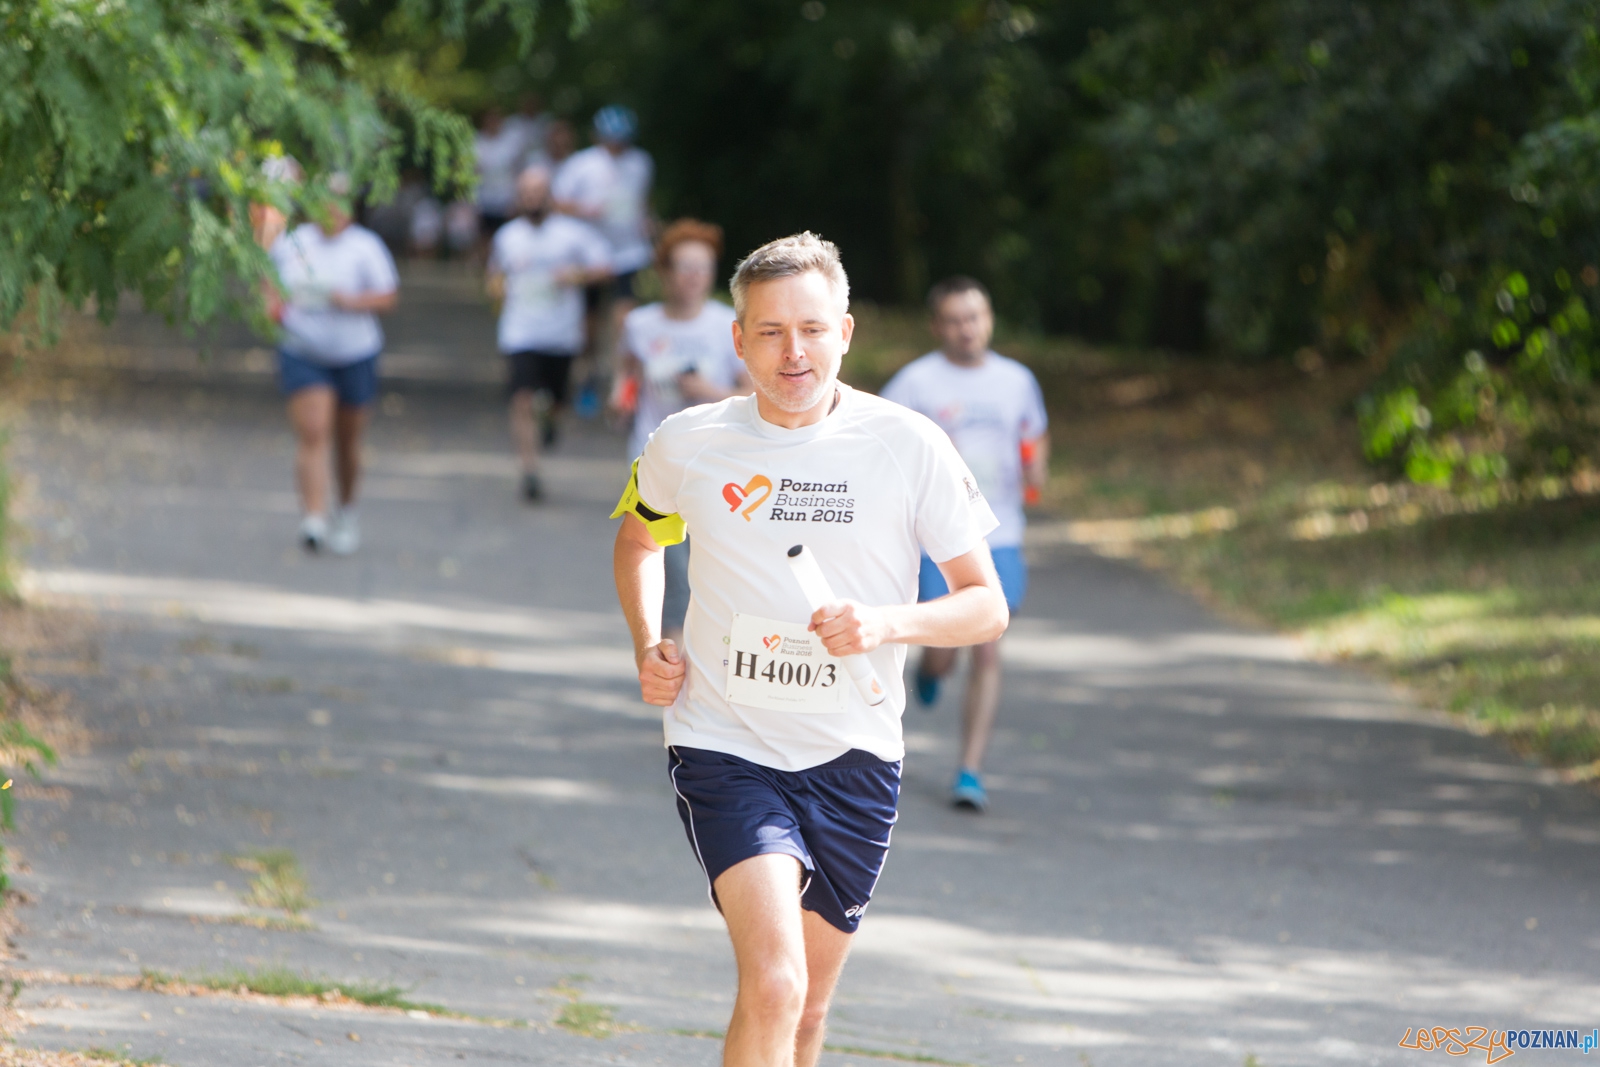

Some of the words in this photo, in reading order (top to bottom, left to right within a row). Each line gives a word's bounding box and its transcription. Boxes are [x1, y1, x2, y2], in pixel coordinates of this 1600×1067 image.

[779, 478, 848, 493] Poznań
[774, 493, 855, 508] Business
[769, 508, 807, 521] Run
[811, 509, 854, 523] 2015
[780, 648, 795, 656] Run
